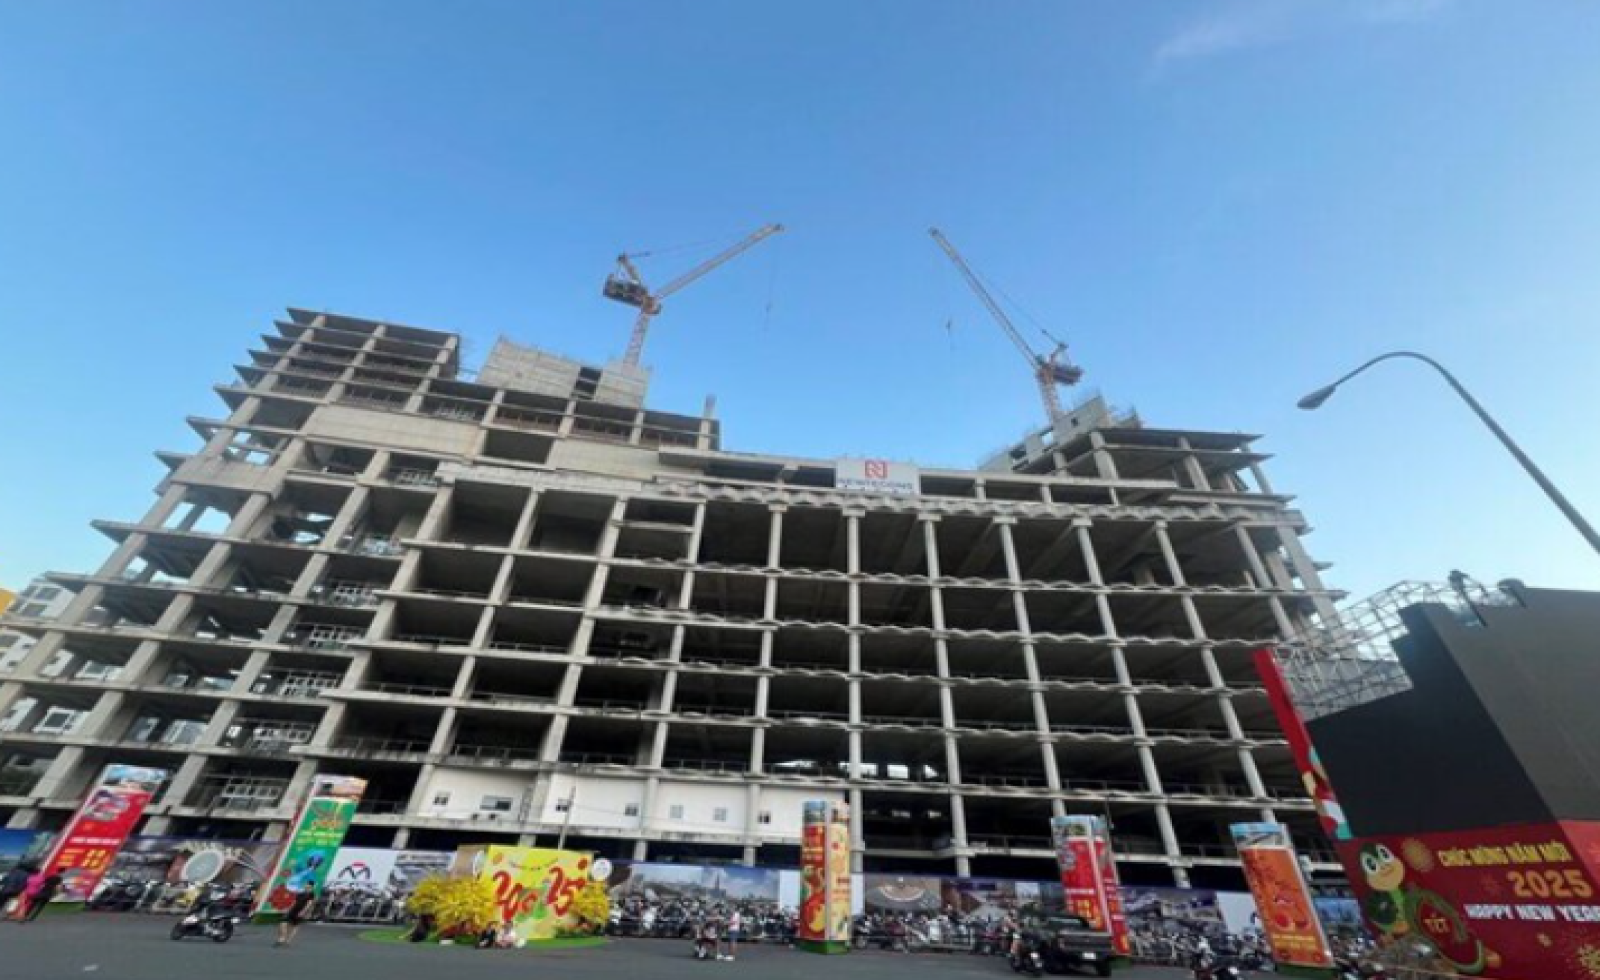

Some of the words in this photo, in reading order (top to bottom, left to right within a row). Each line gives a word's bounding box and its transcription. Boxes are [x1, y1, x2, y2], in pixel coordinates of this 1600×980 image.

[1507, 869, 1592, 898] 2025
[1463, 903, 1515, 920] HAPPY
[1514, 904, 1556, 921] NEW
